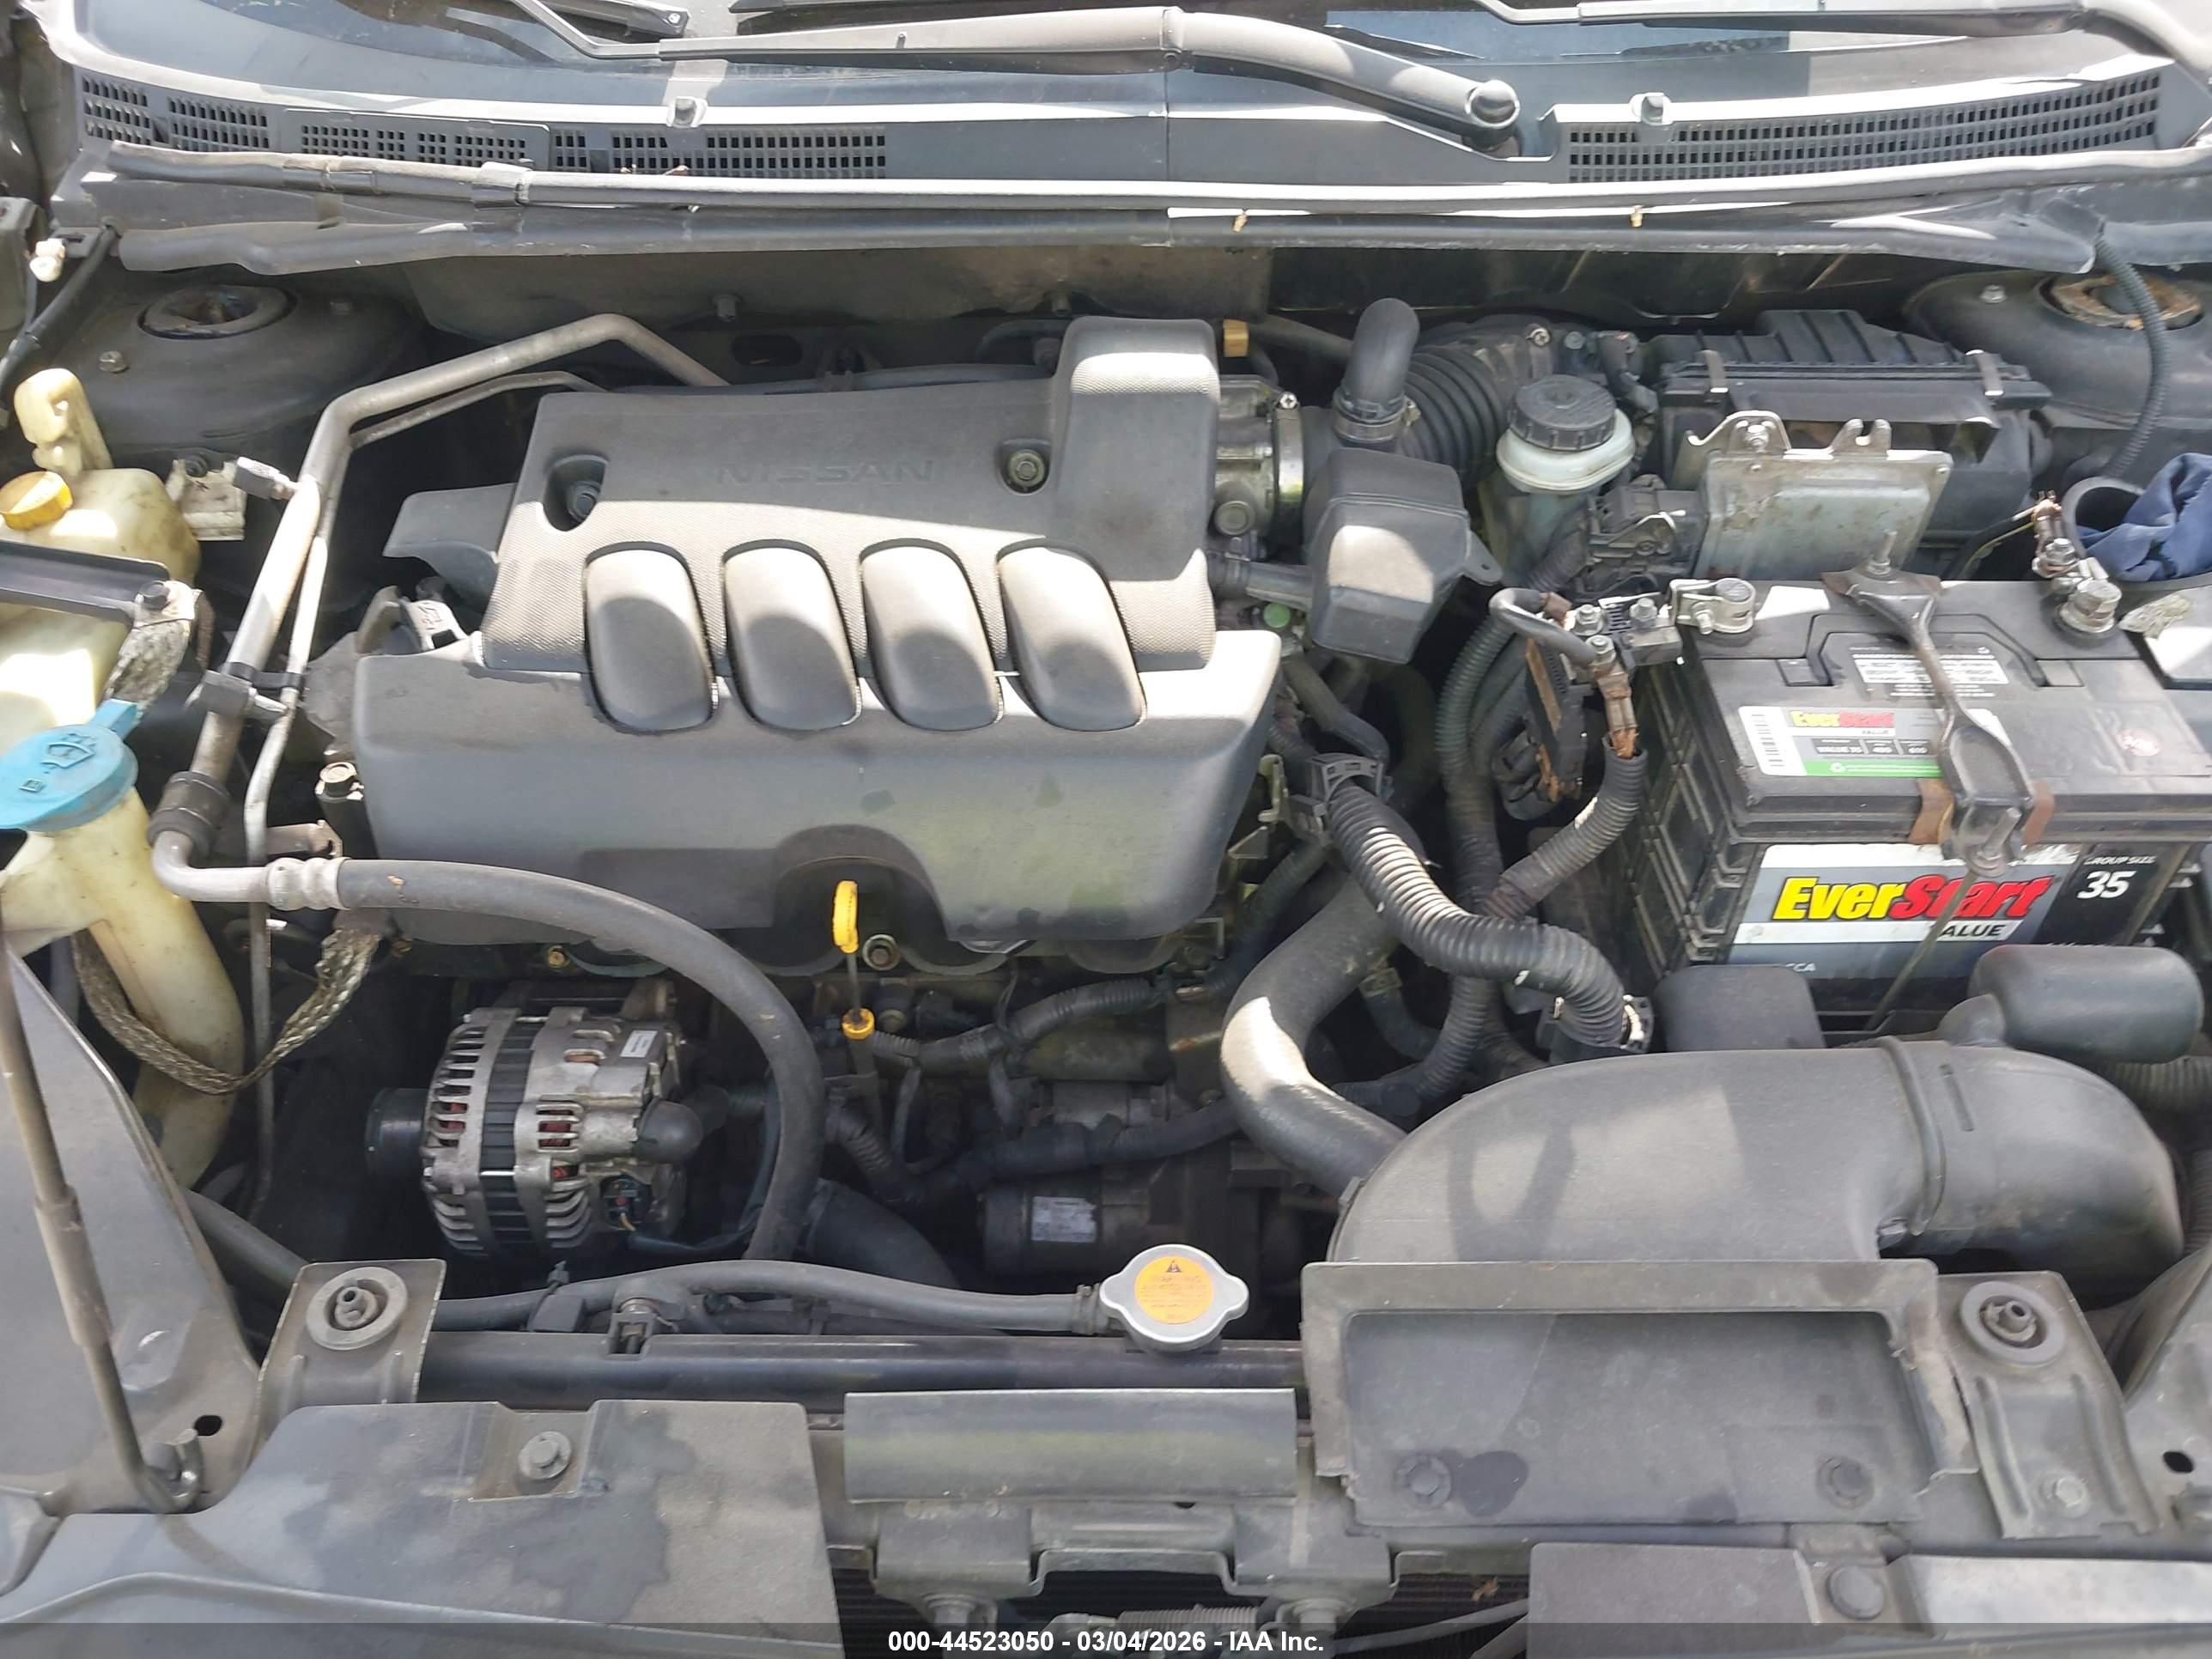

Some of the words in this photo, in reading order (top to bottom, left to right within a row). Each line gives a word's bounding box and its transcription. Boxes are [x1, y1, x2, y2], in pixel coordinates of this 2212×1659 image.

[716, 459, 936, 484] NISSAN
[1771, 874, 2056, 921] EverStart
[2076, 870, 2137, 899] 35
[1938, 924, 2007, 937] ALUE
